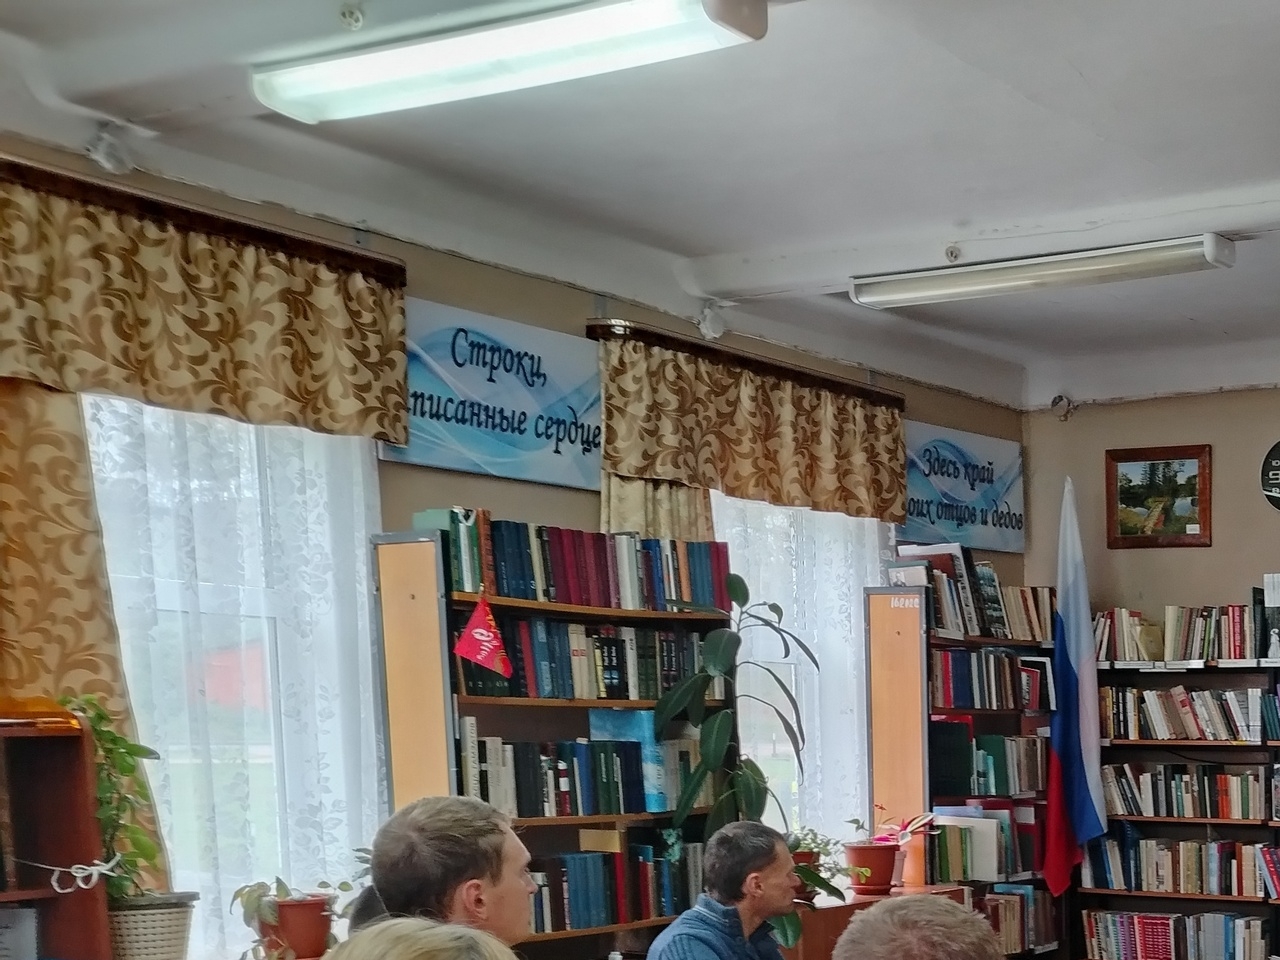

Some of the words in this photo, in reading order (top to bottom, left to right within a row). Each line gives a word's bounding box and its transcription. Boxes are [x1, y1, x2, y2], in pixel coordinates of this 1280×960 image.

[451, 327, 547, 388] Строки,
[407, 389, 528, 436] писанные
[923, 445, 960, 479] Здесь
[963, 460, 994, 491] край
[936, 501, 977, 528] отцов
[979, 507, 989, 526] и
[991, 498, 1024, 531] дедов
